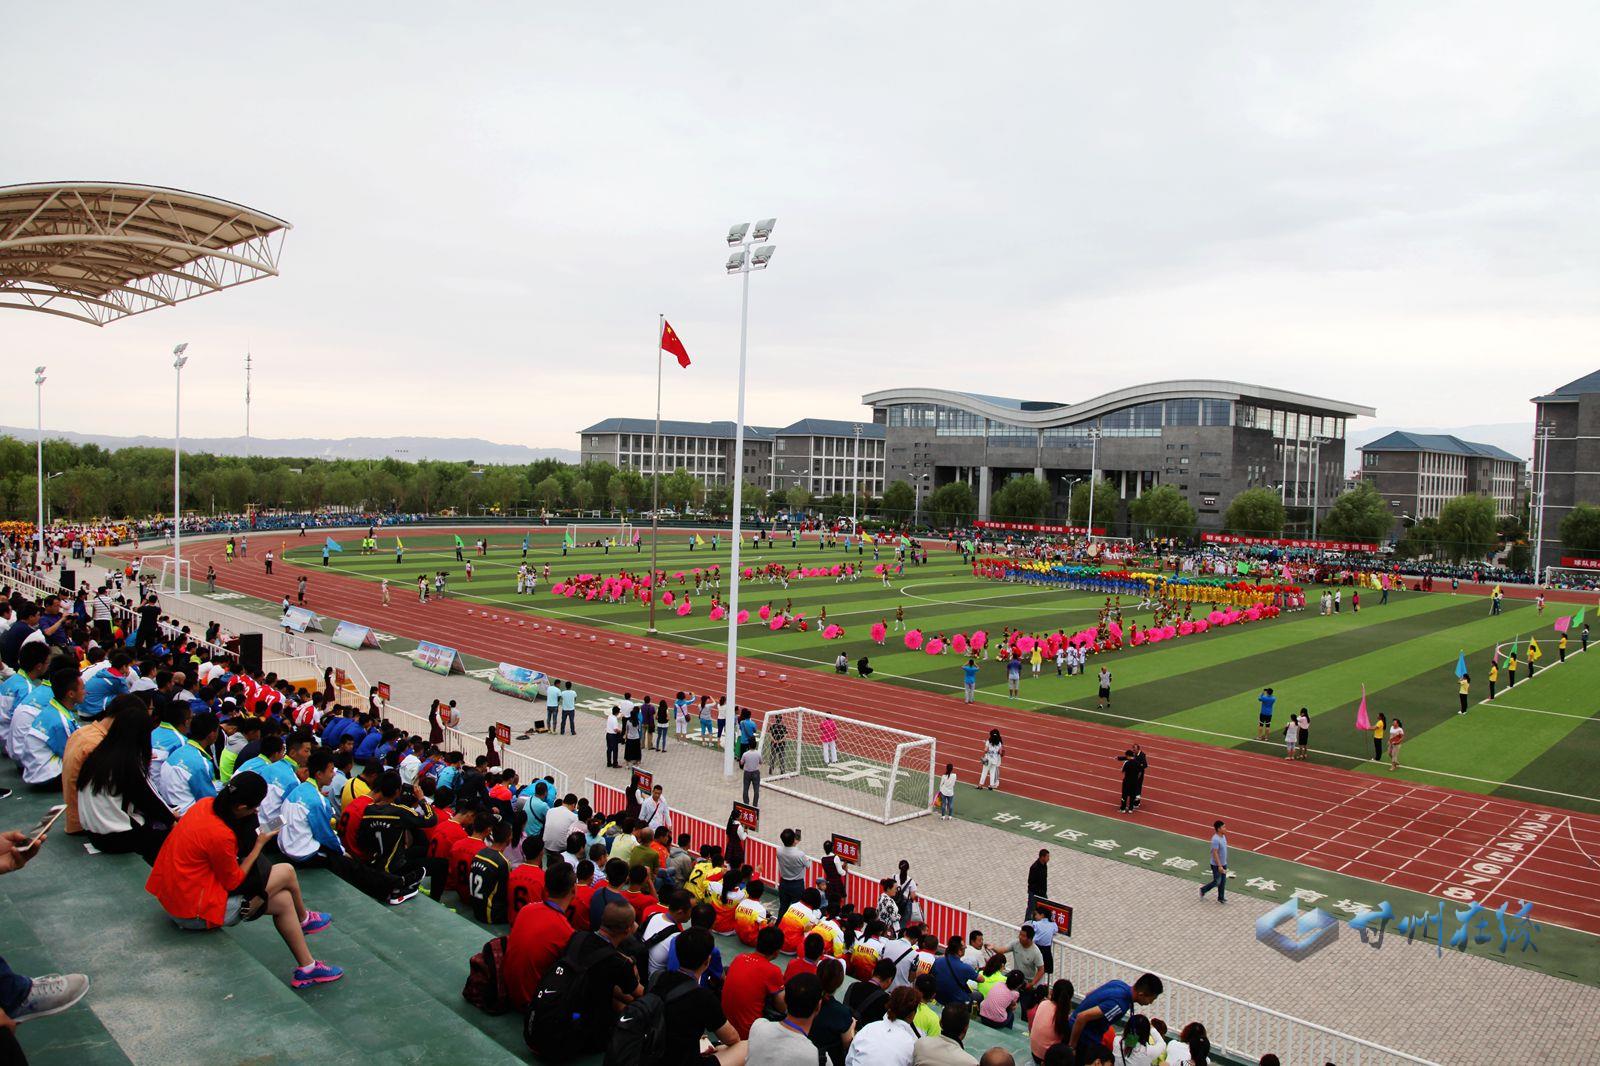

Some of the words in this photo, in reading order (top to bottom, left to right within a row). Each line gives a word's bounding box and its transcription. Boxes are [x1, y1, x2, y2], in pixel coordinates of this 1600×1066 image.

[1535, 813, 1552, 822] 1
[1518, 822, 1548, 832] 2
[1509, 831, 1538, 841] 3
[836, 841, 857, 856] 酒泉市
[1496, 842, 1525, 852] 4
[1485, 852, 1516, 863] 5
[1472, 862, 1504, 875] 6
[690, 869, 704, 885] 2
[1462, 873, 1492, 886] 7
[469, 872, 486, 900] 12
[513, 886, 528, 912] 6
[1442, 887, 1476, 900] 8
[737, 906, 753, 917] CHINA
[787, 907, 805, 920] CHINA
[857, 945, 875, 956] CHINA
